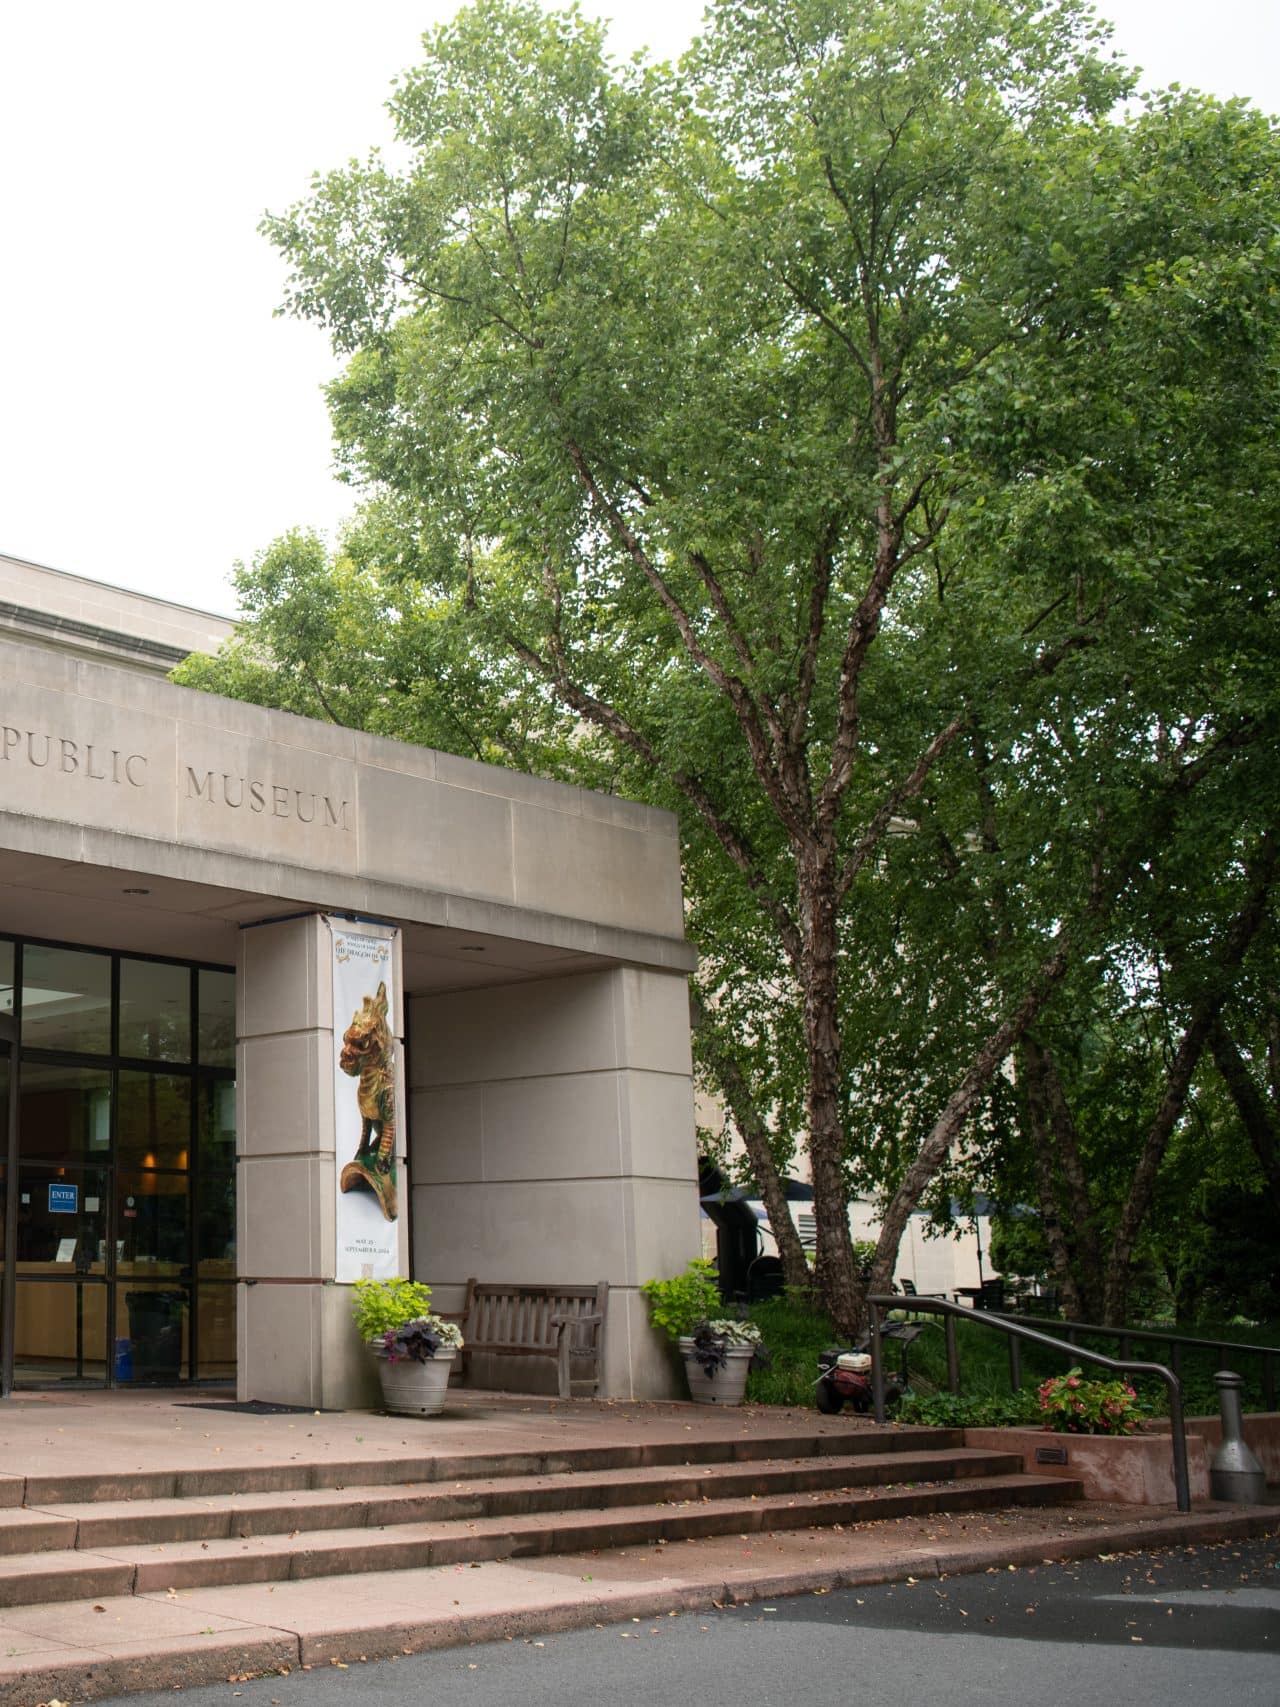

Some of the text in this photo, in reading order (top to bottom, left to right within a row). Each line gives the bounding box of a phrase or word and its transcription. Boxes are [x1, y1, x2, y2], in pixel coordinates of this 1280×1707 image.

[0, 725, 148, 787] PUBLIC
[185, 766, 352, 831] MUSEUM
[51, 1190, 75, 1200] ENTER
